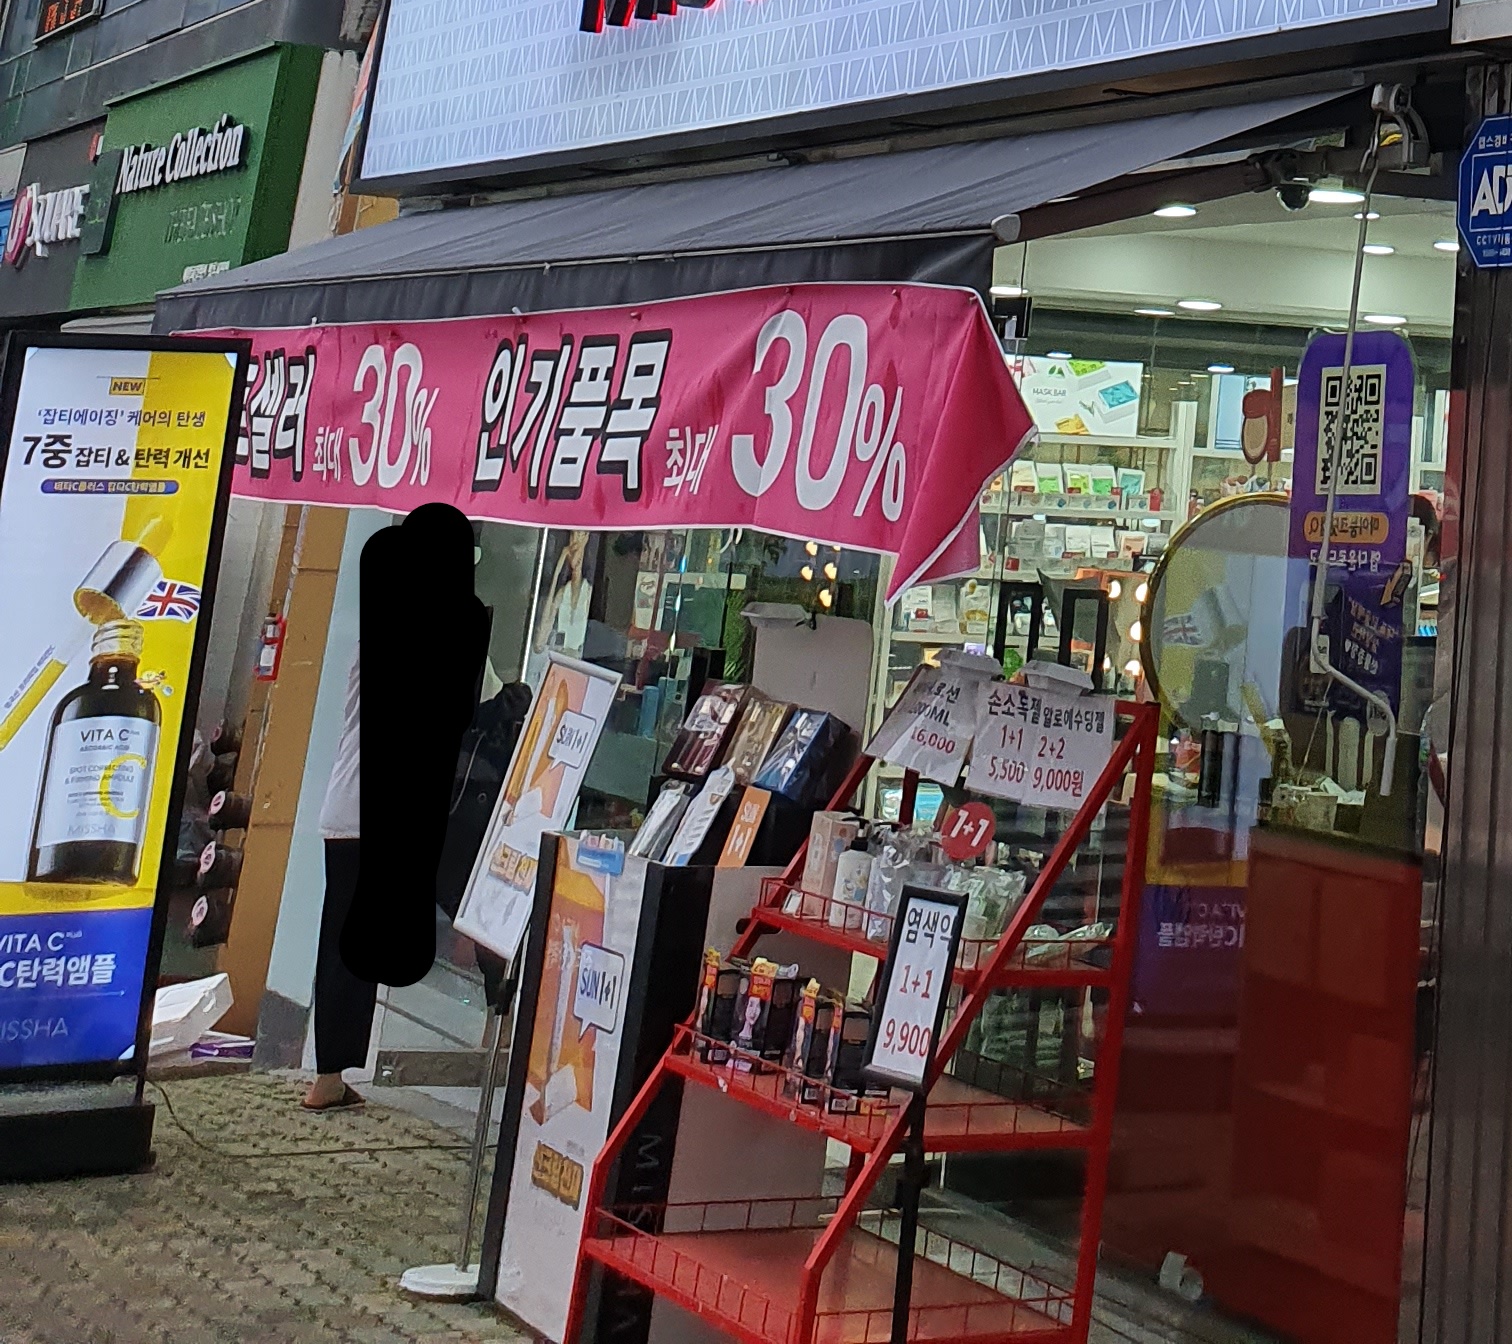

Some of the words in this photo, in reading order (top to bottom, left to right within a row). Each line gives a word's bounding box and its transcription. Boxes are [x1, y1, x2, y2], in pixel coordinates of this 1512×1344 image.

[115, 145, 167, 195] Nature
[165, 113, 244, 184] Collection
[112, 381, 143, 392] NEW
[127, 410, 171, 427] 케어의
[176, 411, 206, 428] 탄생
[313, 425, 343, 483] 최대
[348, 342, 440, 490] 30%
[471, 327, 673, 502] 인기품목
[664, 425, 719, 497] 최대
[731, 309, 907, 524] 30%
[23, 434, 73, 469] 7중
[75, 447, 111, 468] 잡티
[115, 450, 129, 467] &
[135, 448, 169, 468] 탄력
[173, 447, 210, 469] 개선
[988, 688, 1042, 725] 손소독젤
[81, 729, 114, 742] VITA
[119, 729, 130, 741] C
[910, 726, 956, 754] 16,000
[1001, 725, 1024, 751] 1+1
[1037, 736, 1065, 760] 2+2
[988, 756, 1025, 783] 5,500
[1032, 767, 1084, 798] 9,000원
[948, 808, 991, 849] 1+1
[47, 931, 64, 951] C
[899, 964, 933, 999] 1+1
[883, 1018, 931, 1057] 9,900
